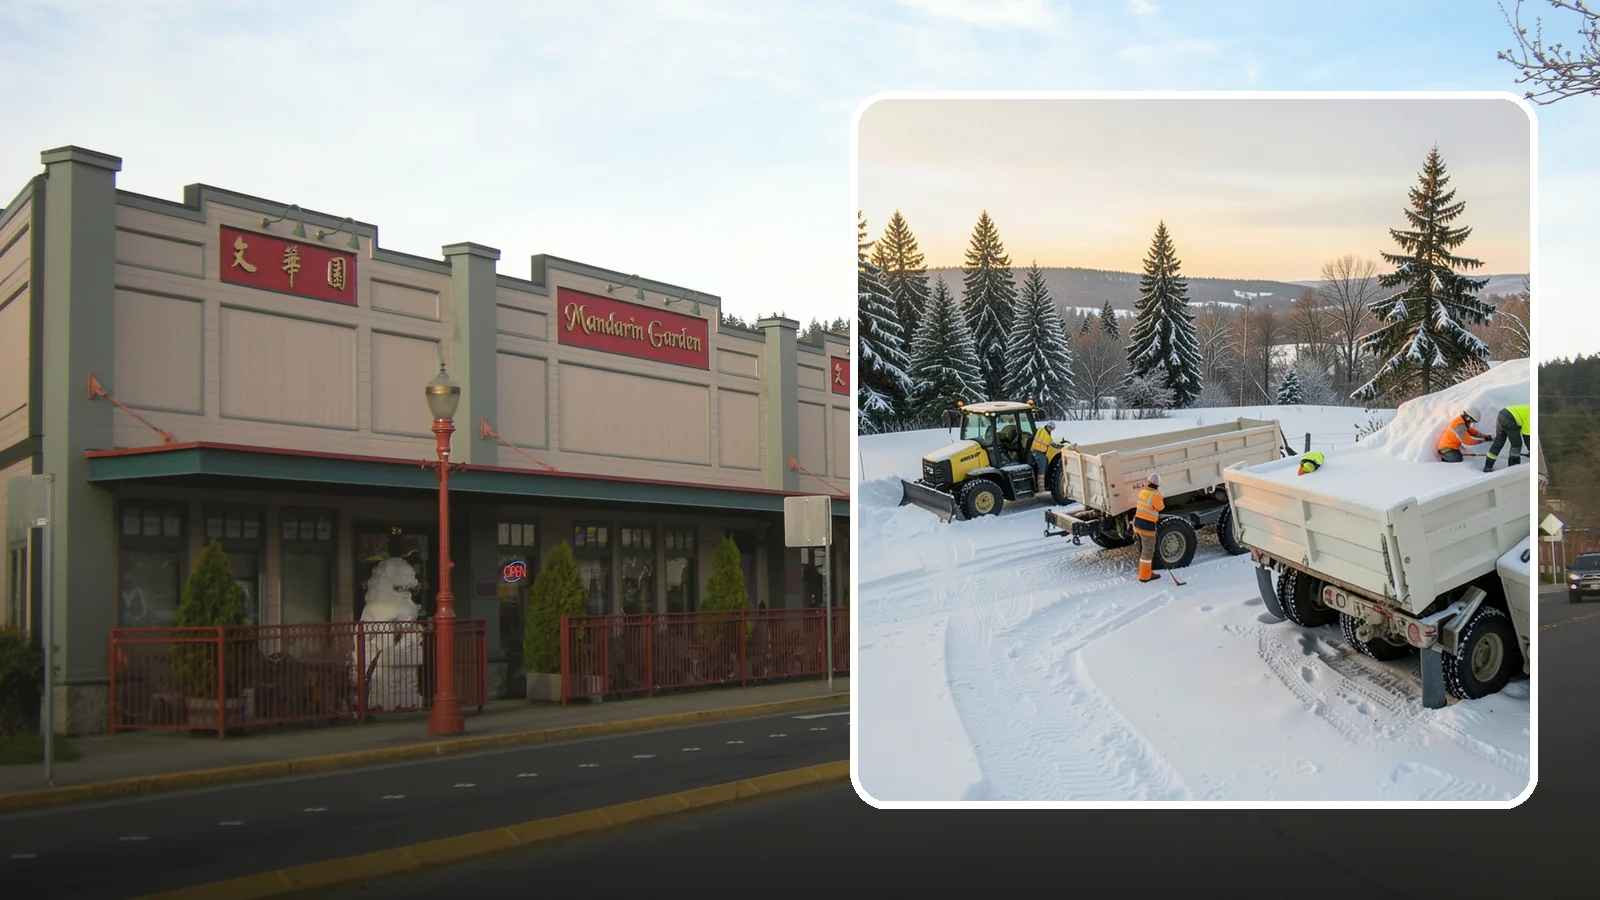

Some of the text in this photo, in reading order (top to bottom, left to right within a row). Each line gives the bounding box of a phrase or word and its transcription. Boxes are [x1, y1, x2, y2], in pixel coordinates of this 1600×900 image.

[231, 236, 346, 291] 文華園
[564, 302, 701, 352] Mandarin Garden
[503, 565, 527, 578] OPEN
